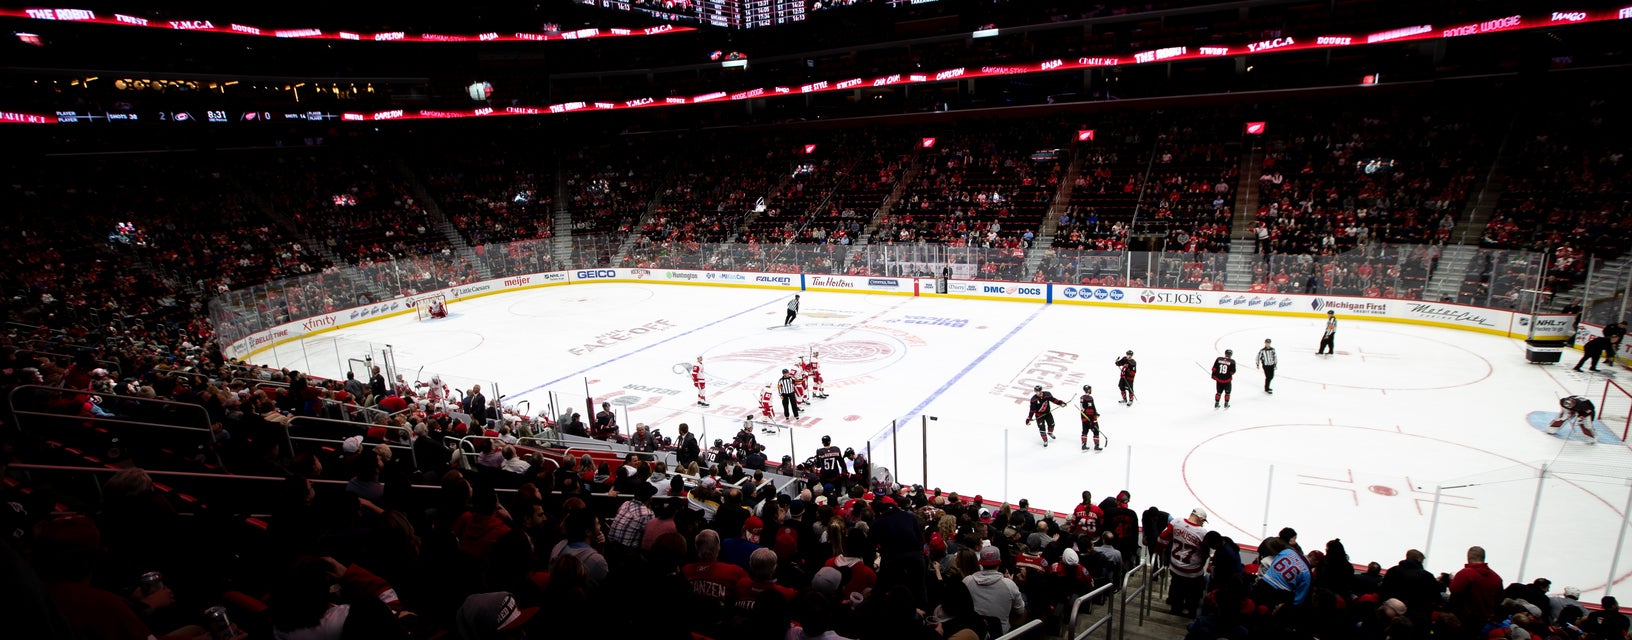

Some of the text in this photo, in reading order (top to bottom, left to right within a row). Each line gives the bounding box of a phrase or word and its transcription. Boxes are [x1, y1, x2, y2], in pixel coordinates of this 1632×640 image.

[26, 9, 96, 20] THE ROBOT
[114, 14, 148, 26] TWIST
[1551, 12, 1586, 21] TANGO
[1443, 14, 1521, 38] BOOGIE WOOGIE
[375, 32, 404, 41] CARLTON
[479, 32, 499, 41] SALSA
[562, 31, 577, 40] THE
[1134, 50, 1155, 64] THE
[1200, 47, 1228, 56] TWIST
[1041, 59, 1062, 70] SALSA
[936, 68, 964, 80] CARLTON
[802, 81, 828, 93] FREE STYLE
[836, 78, 862, 90] SWING
[474, 107, 493, 116] SALSA
[550, 104, 564, 113] THE
[159, 112, 165, 120] 2
[207, 111, 226, 119] 8:31
[374, 110, 403, 120] CARLTON
[577, 270, 616, 279] GEICO
[672, 272, 698, 280] Huntington
[504, 276, 530, 287] meijer
[812, 276, 854, 288] Tim Hortons
[1157, 292, 1202, 304] ST. JOE'S
[1325, 300, 1386, 311] Michigan First
[303, 316, 336, 331] xfinity
[904, 315, 969, 323] Wilcox
[904, 319, 967, 328] Burns
[1456, 312, 1495, 326] City
[274, 330, 288, 338] TIRE
[567, 319, 670, 356] FACE-OFF
[1220, 365, 1228, 374] 19
[624, 383, 681, 396] BELFOR
[823, 458, 835, 470] 57
[1172, 540, 1195, 564] 27
[1274, 558, 1300, 582] 66
